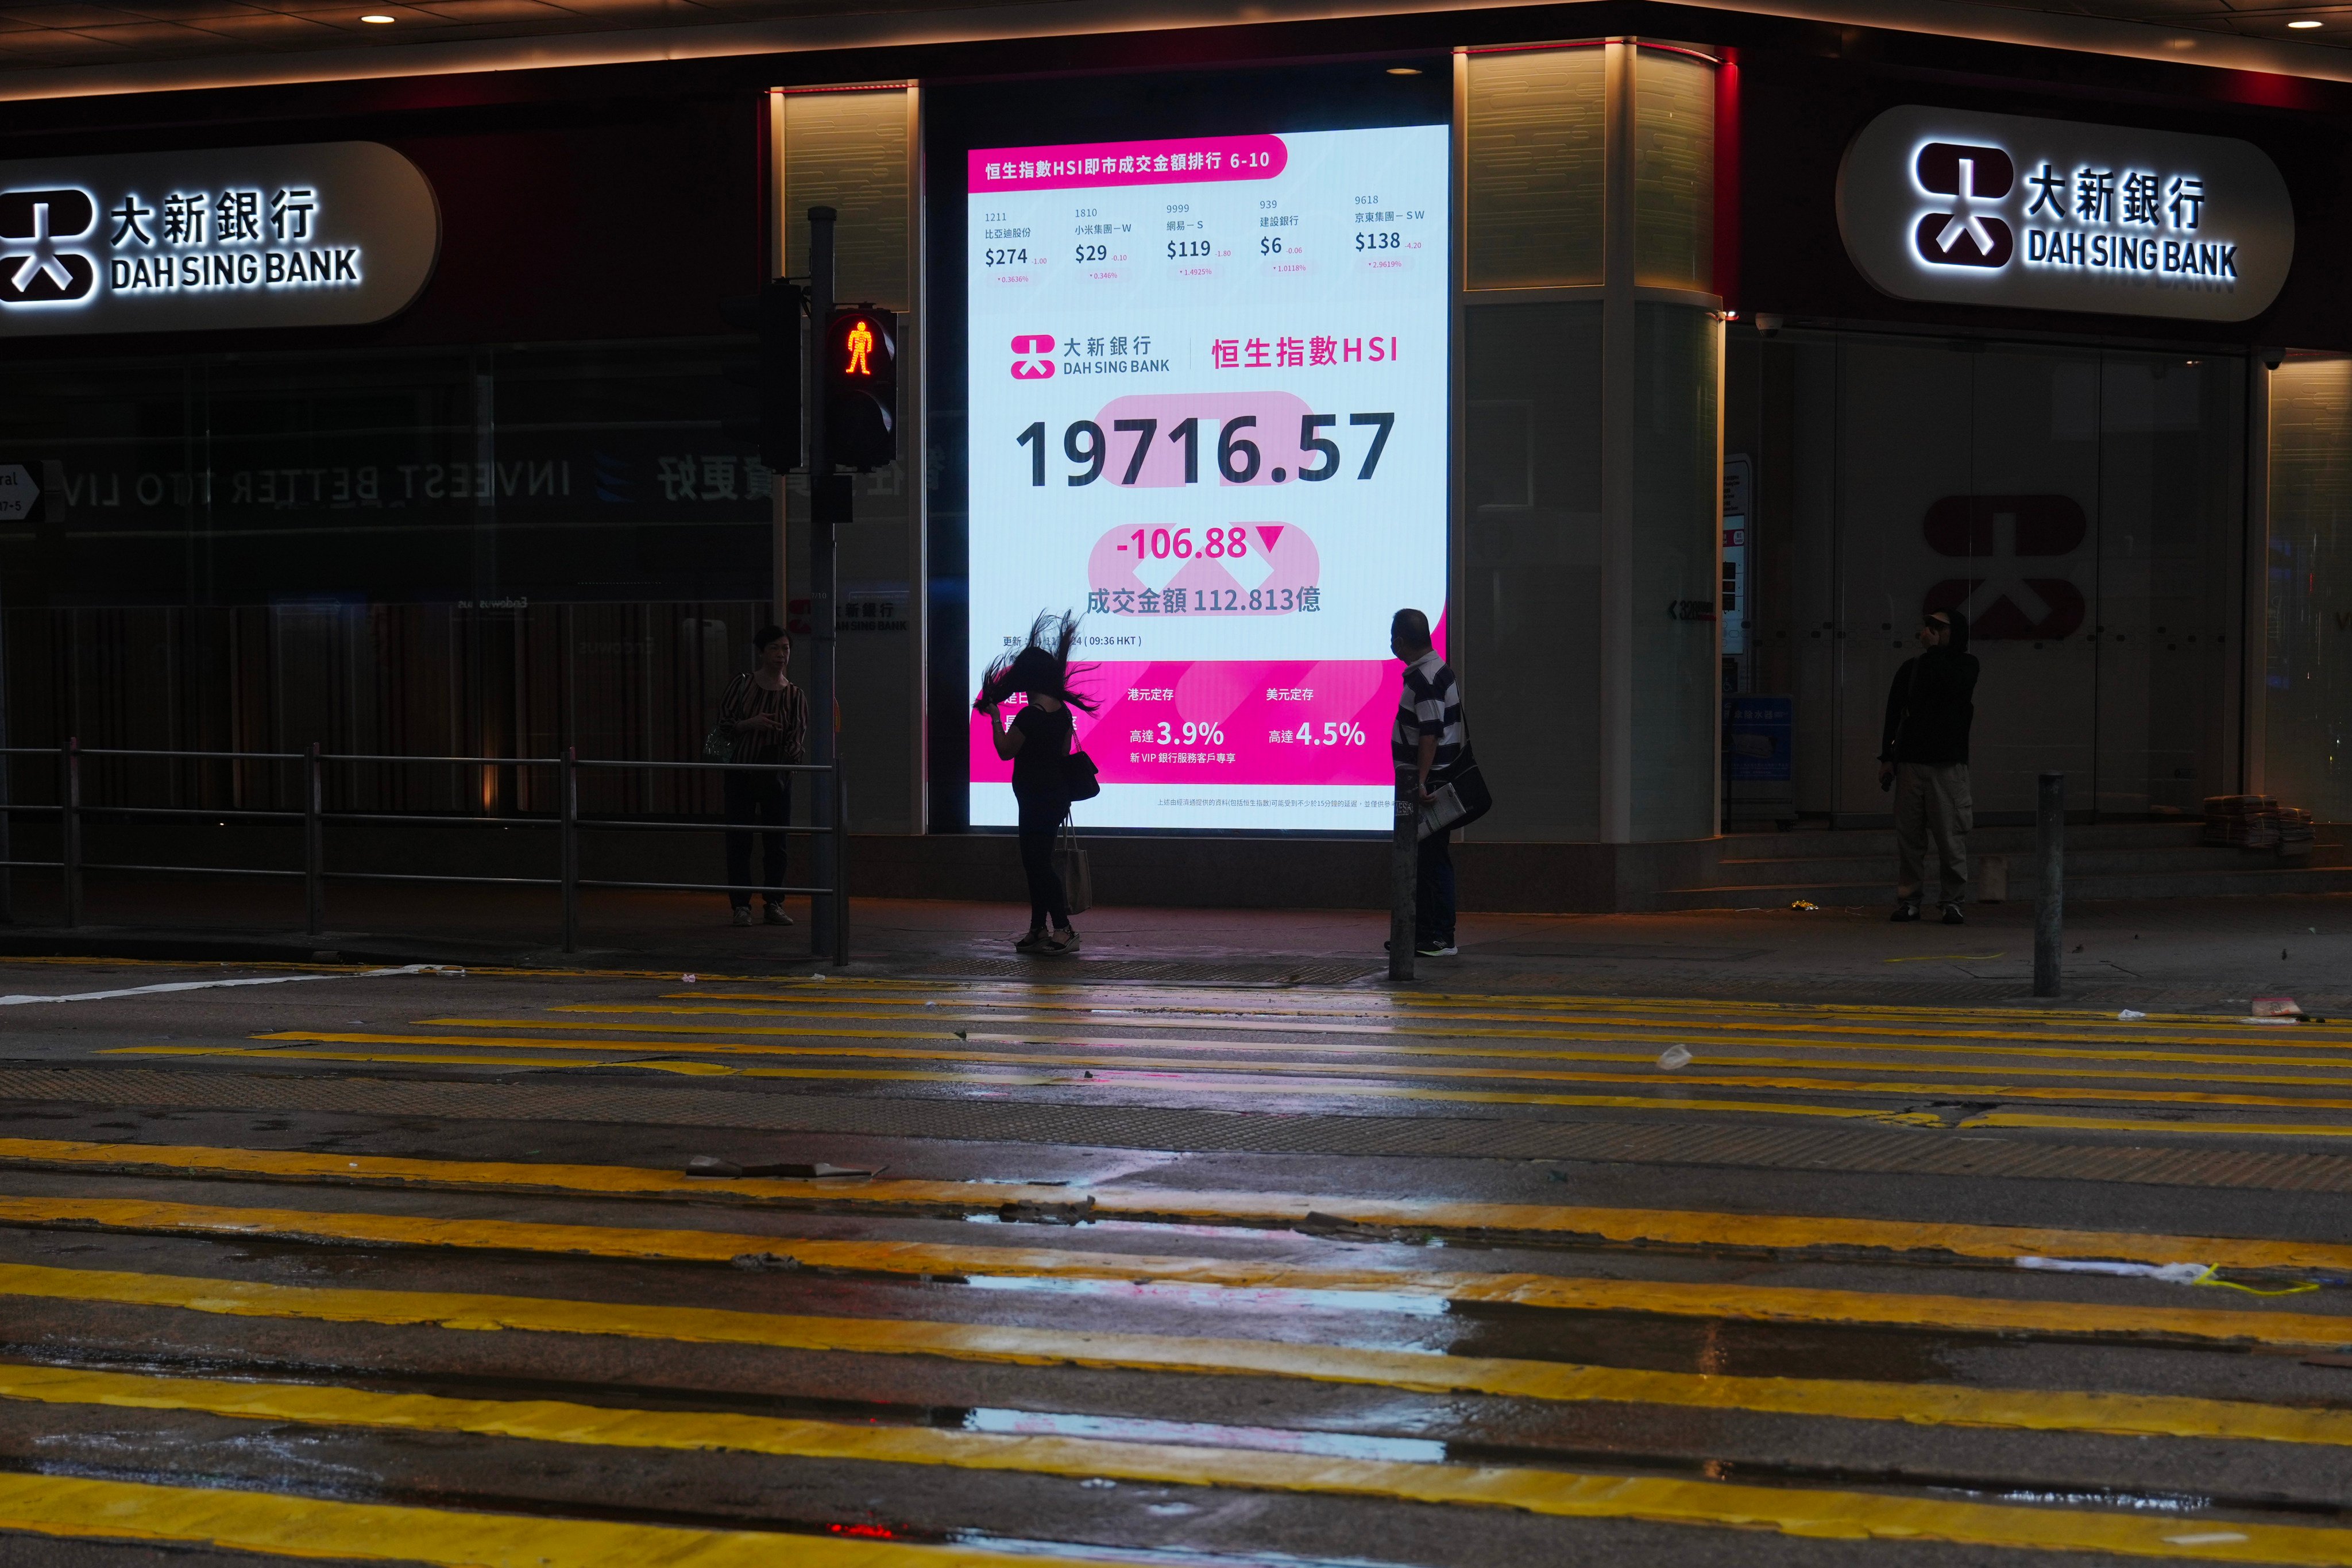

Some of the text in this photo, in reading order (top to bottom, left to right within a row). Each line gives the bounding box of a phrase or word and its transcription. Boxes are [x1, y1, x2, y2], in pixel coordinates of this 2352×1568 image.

[984, 151, 1269, 180] 恒生指數HSI即市成交金額排行 6-10
[1260, 200, 1277, 208] 939
[1355, 196, 1378, 204] 9618
[2027, 164, 2205, 229] 大新銀行
[110, 188, 315, 246] 大新銀行
[986, 213, 1006, 221] 1211
[1076, 208, 1096, 217] 1810
[1167, 204, 1189, 213] 9999
[1260, 216, 1298, 227] 建設銀行
[986, 227, 1030, 238] 比亞迪股份
[1168, 241, 1210, 260] $119
[1261, 237, 1281, 256] $6
[1356, 233, 1400, 252] $138
[986, 248, 1048, 267] $274 -1.00
[1076, 245, 1106, 263] $29
[2027, 230, 2238, 277] DAH SING BANK
[111, 248, 358, 290] DAH SING BANK
[1064, 336, 1150, 357] 大新銀行
[1212, 335, 1396, 369] 恒生指數HSI
[1064, 360, 1169, 374] DAH SING BANK
[1017, 412, 1394, 486] 19716.57
[1117, 527, 1246, 559] -106.88
[1087, 586, 1320, 613] 成交金額 112.813億
[851, 621, 876, 631] SING
[877, 620, 907, 631] BANK
[1002, 635, 1022, 647] 更新
[1128, 688, 1173, 700] 港元定存
[1266, 688, 1314, 701] 美元定存
[1130, 722, 1223, 745] 高達 3.9%
[1269, 723, 1365, 745] 高達 4.5%
[1130, 752, 1235, 763] 新 VIP 銀行服務客戶專享
